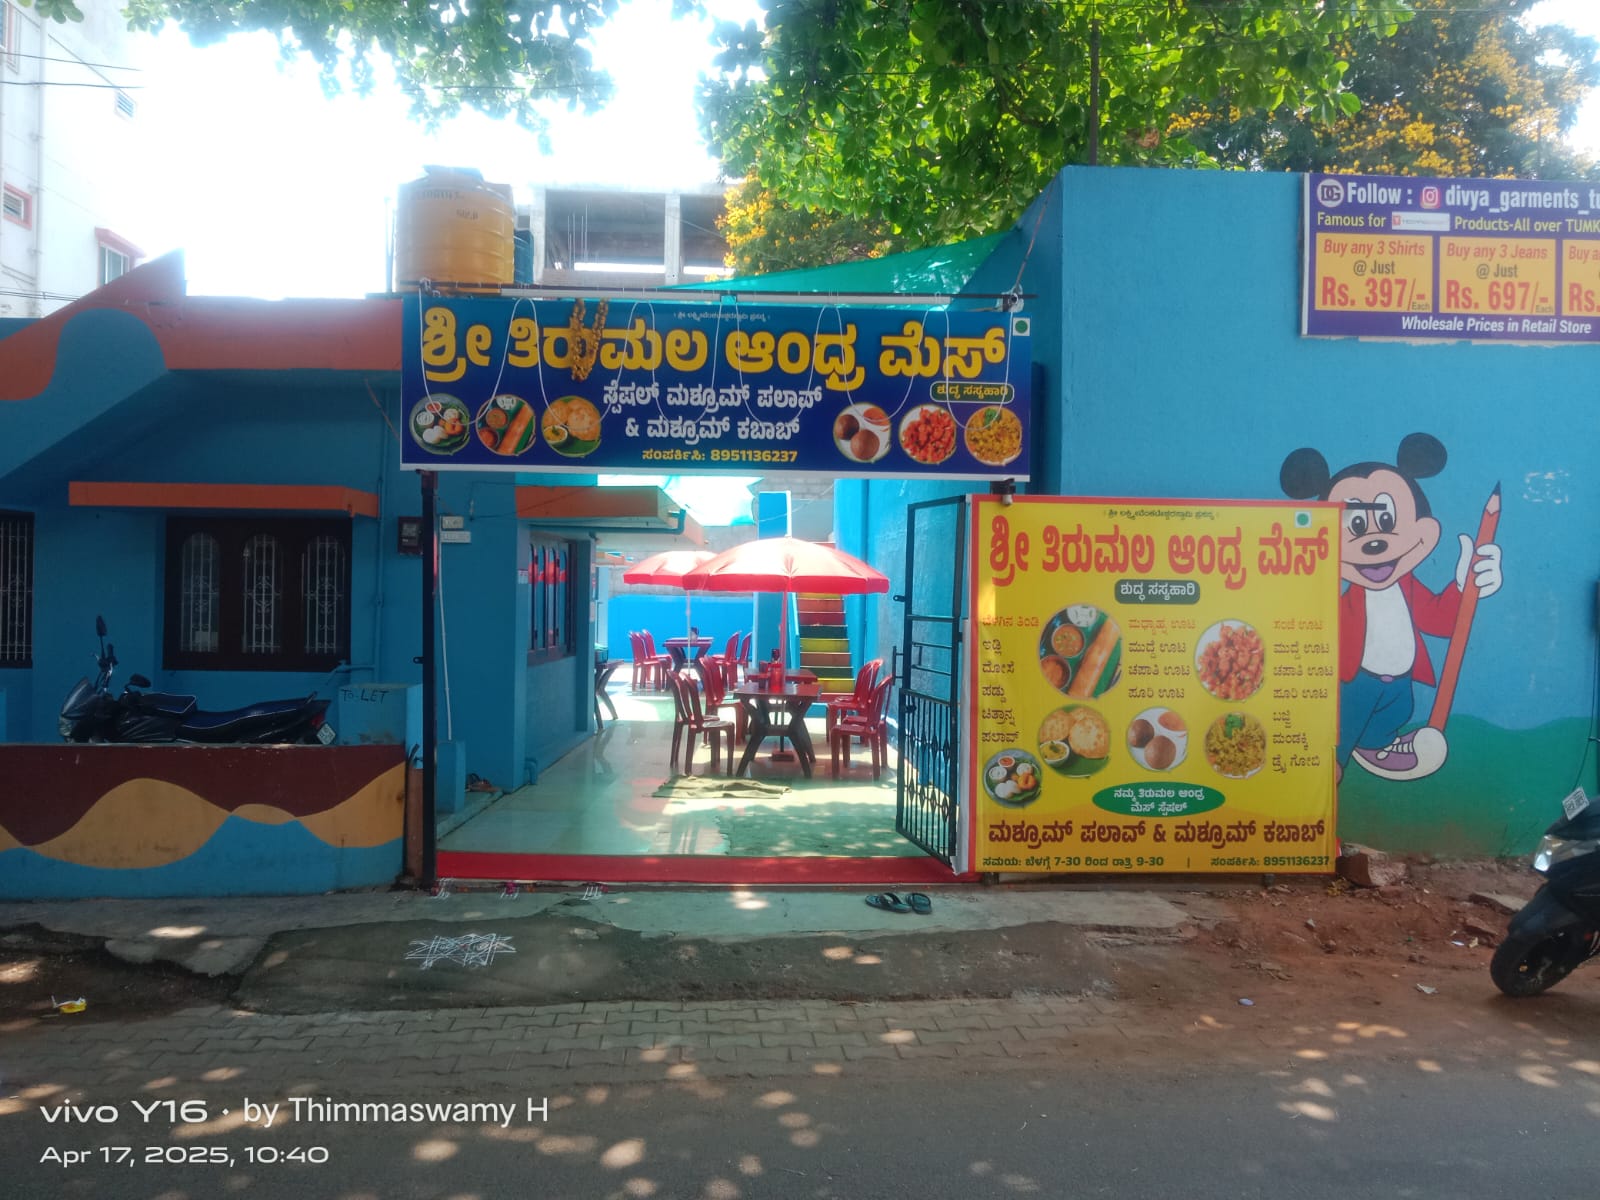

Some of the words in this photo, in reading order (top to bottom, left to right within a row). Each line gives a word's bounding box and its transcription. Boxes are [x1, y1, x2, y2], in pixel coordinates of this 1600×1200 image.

[1347, 182, 1401, 205] Follow
[1317, 212, 1365, 227] Famous
[1368, 213, 1386, 227] for
[1534, 222, 1562, 233] over
[1324, 239, 1347, 258] Buy
[1350, 242, 1373, 258] any
[1377, 240, 1385, 255] 3
[1388, 240, 1425, 256] Shirts
[1446, 243, 1470, 261] Buy
[1473, 245, 1496, 261] any
[1499, 244, 1508, 258] 3
[1511, 245, 1548, 260] Jeans
[1568, 245, 1590, 264] Buy
[1592, 250, 1600, 261] a
[1370, 260, 1395, 275] Just
[1494, 264, 1519, 279] Just
[1322, 276, 1356, 307] Rs.
[1365, 277, 1426, 311] 397/-
[1446, 279, 1480, 310] Rs.
[1488, 280, 1549, 314] 697/-
[1411, 302, 1430, 312] Each
[1535, 304, 1554, 314] Each
[1401, 315, 1463, 332] Wholesale
[1466, 317, 1505, 332] Prices
[1507, 317, 1519, 332] in
[1521, 318, 1556, 333] Retail
[1559, 320, 1592, 334] Store
[422, 306, 492, 383] ಶ್ರೀ
[508, 316, 708, 373] ತಿರುಮಲ
[879, 320, 1006, 379] ಮೆಸ್
[666, 383, 750, 413] ಮಶ್ರೂಮ್
[625, 418, 640, 438] &
[646, 415, 731, 446] ಮಶ್ರೂಮ್
[736, 418, 801, 441] ಕಬಾಬ್
[709, 448, 798, 463] 8951136237
[989, 514, 1030, 587] ಶ್ರೀ
[1042, 523, 1156, 574] ತಿರುಮಲ
[1257, 521, 1329, 576] ಮೆಸ್
[1159, 642, 1187, 653] ಊಟ
[1303, 643, 1330, 654] ಊಟ
[1163, 665, 1191, 676] ಊಟ
[1307, 665, 1334, 677] ಊಟ
[1158, 687, 1185, 699] ಊಟ
[1302, 687, 1328, 699] ಊಟ
[1138, 788, 1175, 798] ತಿರುಮಲ
[988, 819, 1073, 849] ಮಶ್ರೂಮ್
[1080, 820, 1146, 843] ಪಲಾವ್
[1152, 823, 1167, 843] &
[1174, 819, 1257, 849] ಮಶ್ರೂಮ್
[1263, 819, 1325, 843] ಕಬಾಬ್
[1054, 856, 1081, 867] 7-30
[1085, 857, 1109, 867] ರಿಂದ
[1136, 857, 1165, 867] 9-30
[1263, 856, 1330, 867] 8951136237
